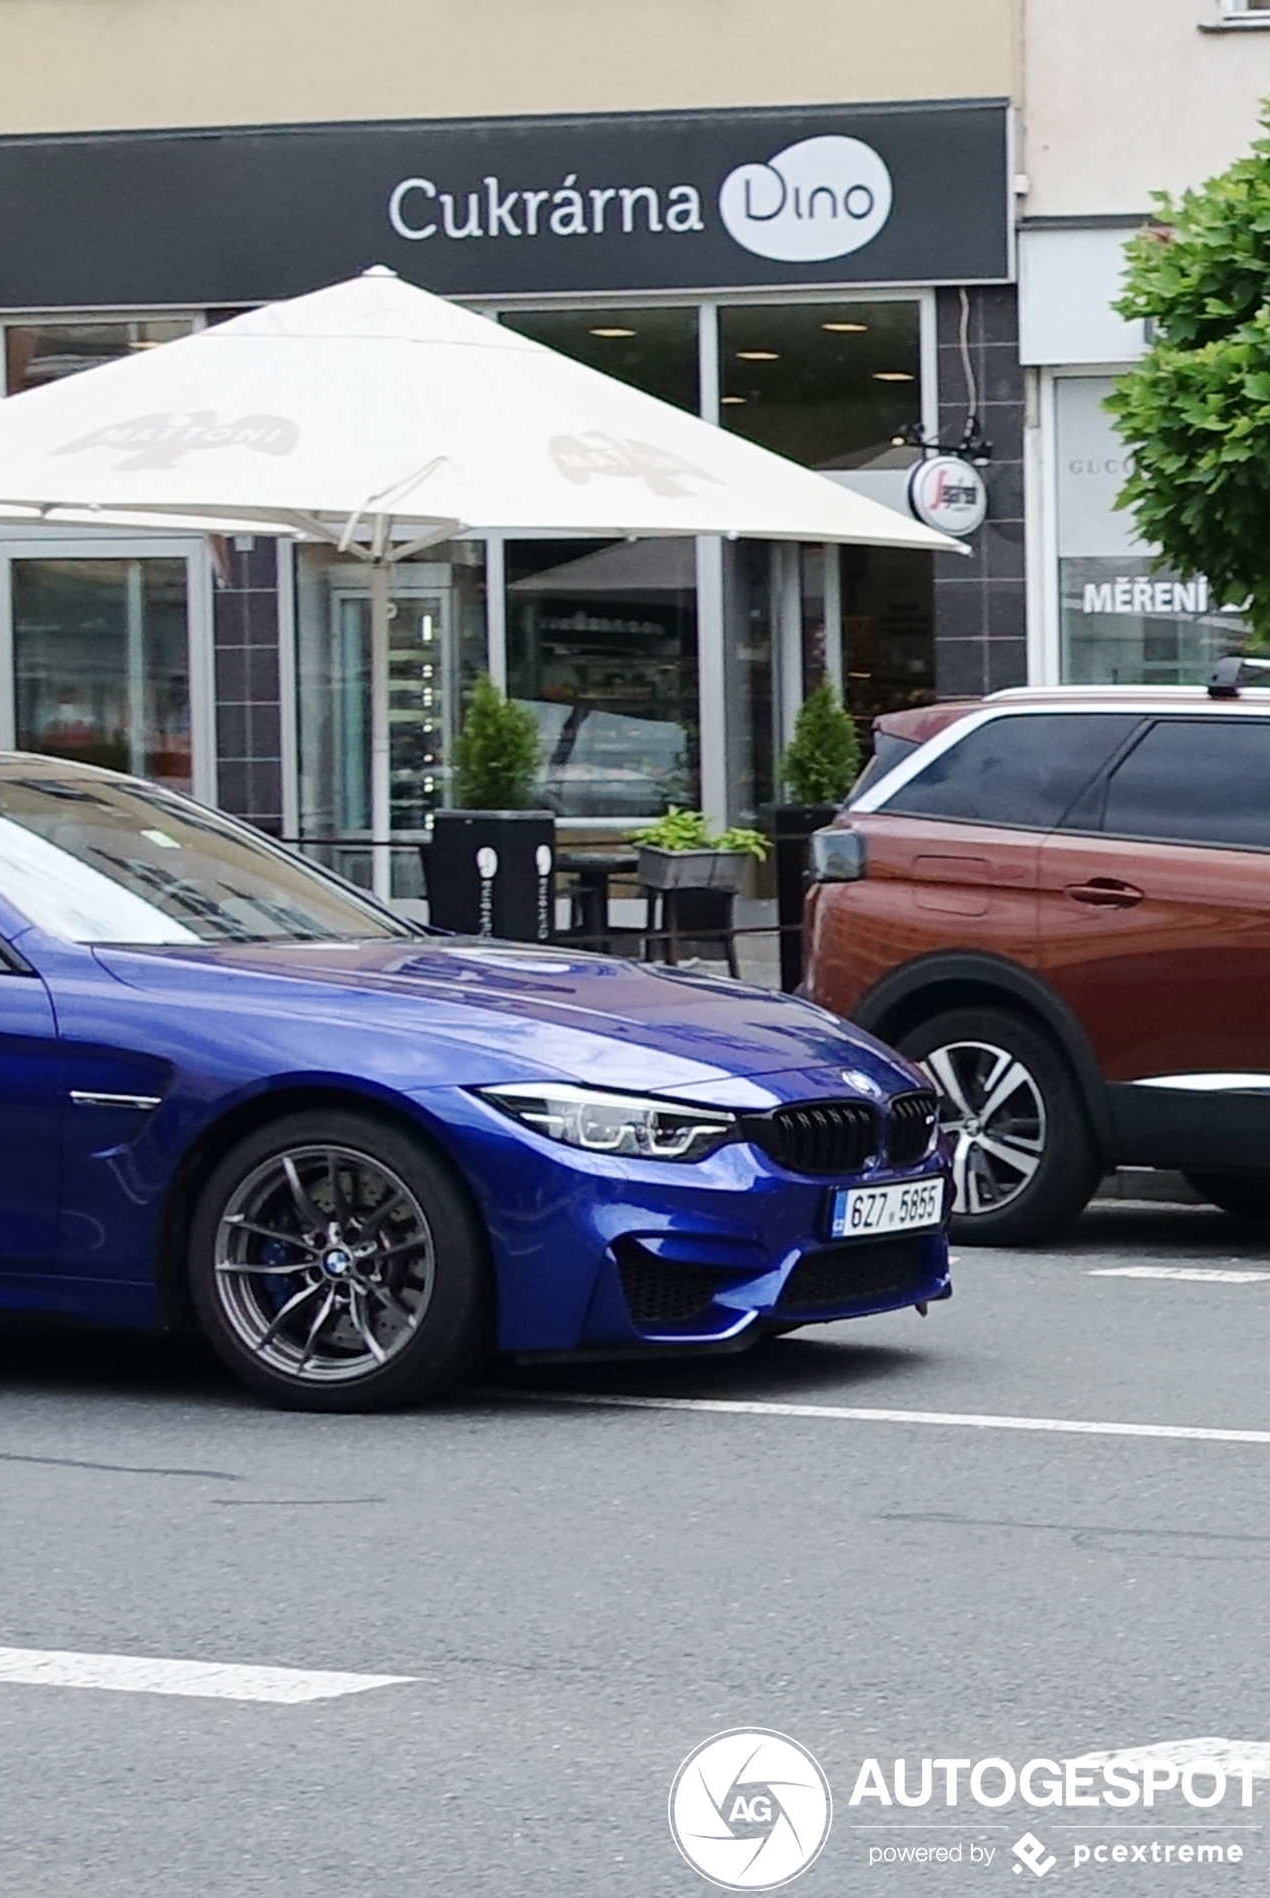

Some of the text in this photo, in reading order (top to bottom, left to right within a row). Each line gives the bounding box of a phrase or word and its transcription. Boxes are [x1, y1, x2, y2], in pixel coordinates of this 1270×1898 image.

[388, 175, 875, 240] Cukrárna Dino
[1083, 576, 1209, 613] MĚŘENÍ
[852, 1186, 937, 1228] 6Z7 5855
